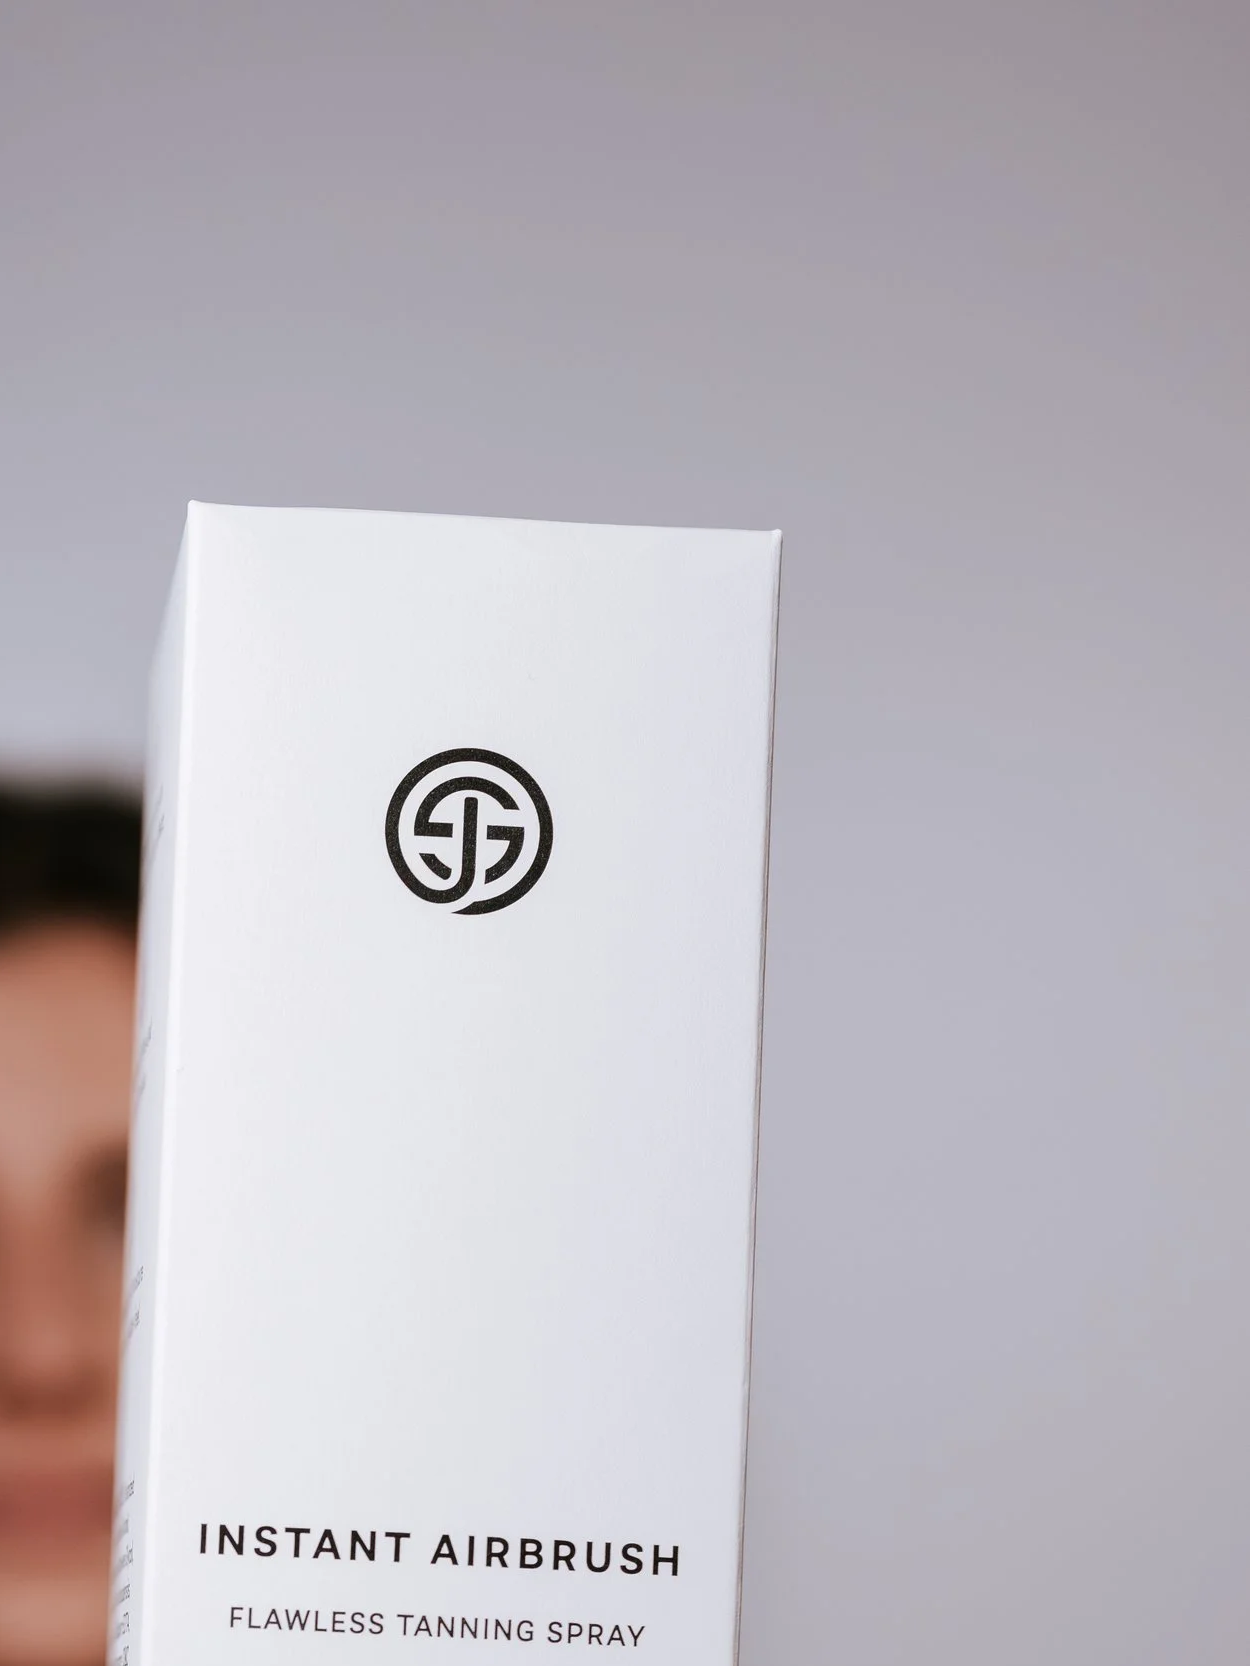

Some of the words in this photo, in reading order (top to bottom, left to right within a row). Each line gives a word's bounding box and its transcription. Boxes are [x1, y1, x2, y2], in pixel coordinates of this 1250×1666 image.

[199, 1523, 411, 1564] INSTANT
[429, 1533, 680, 1577] AIRBRUSH
[229, 1606, 385, 1636] FLAWLESS
[396, 1613, 535, 1643] TANNING
[546, 1620, 646, 1648] SPRAY
